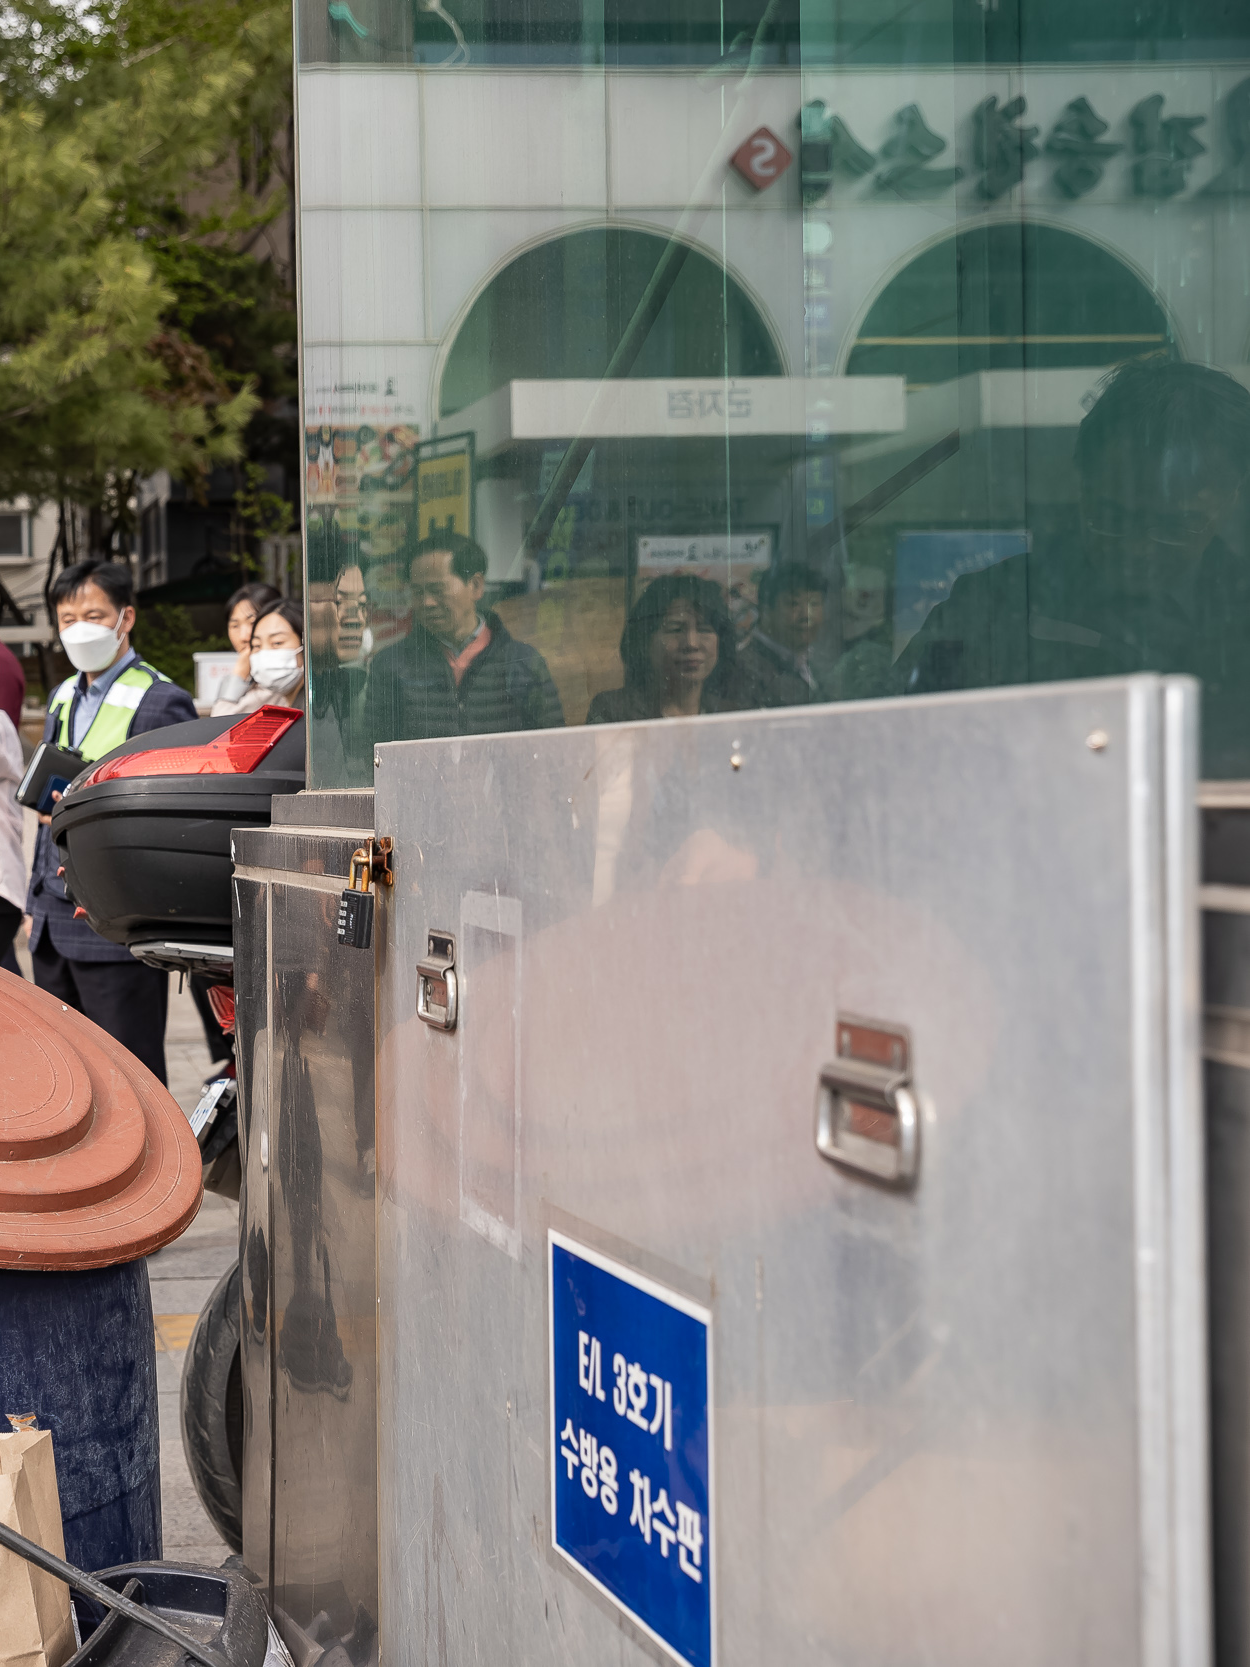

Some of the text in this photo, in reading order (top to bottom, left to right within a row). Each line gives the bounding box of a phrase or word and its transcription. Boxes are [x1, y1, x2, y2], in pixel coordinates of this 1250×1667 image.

[612, 1352, 673, 1451] 3호기
[560, 1418, 703, 1583] 수방용 차수판
